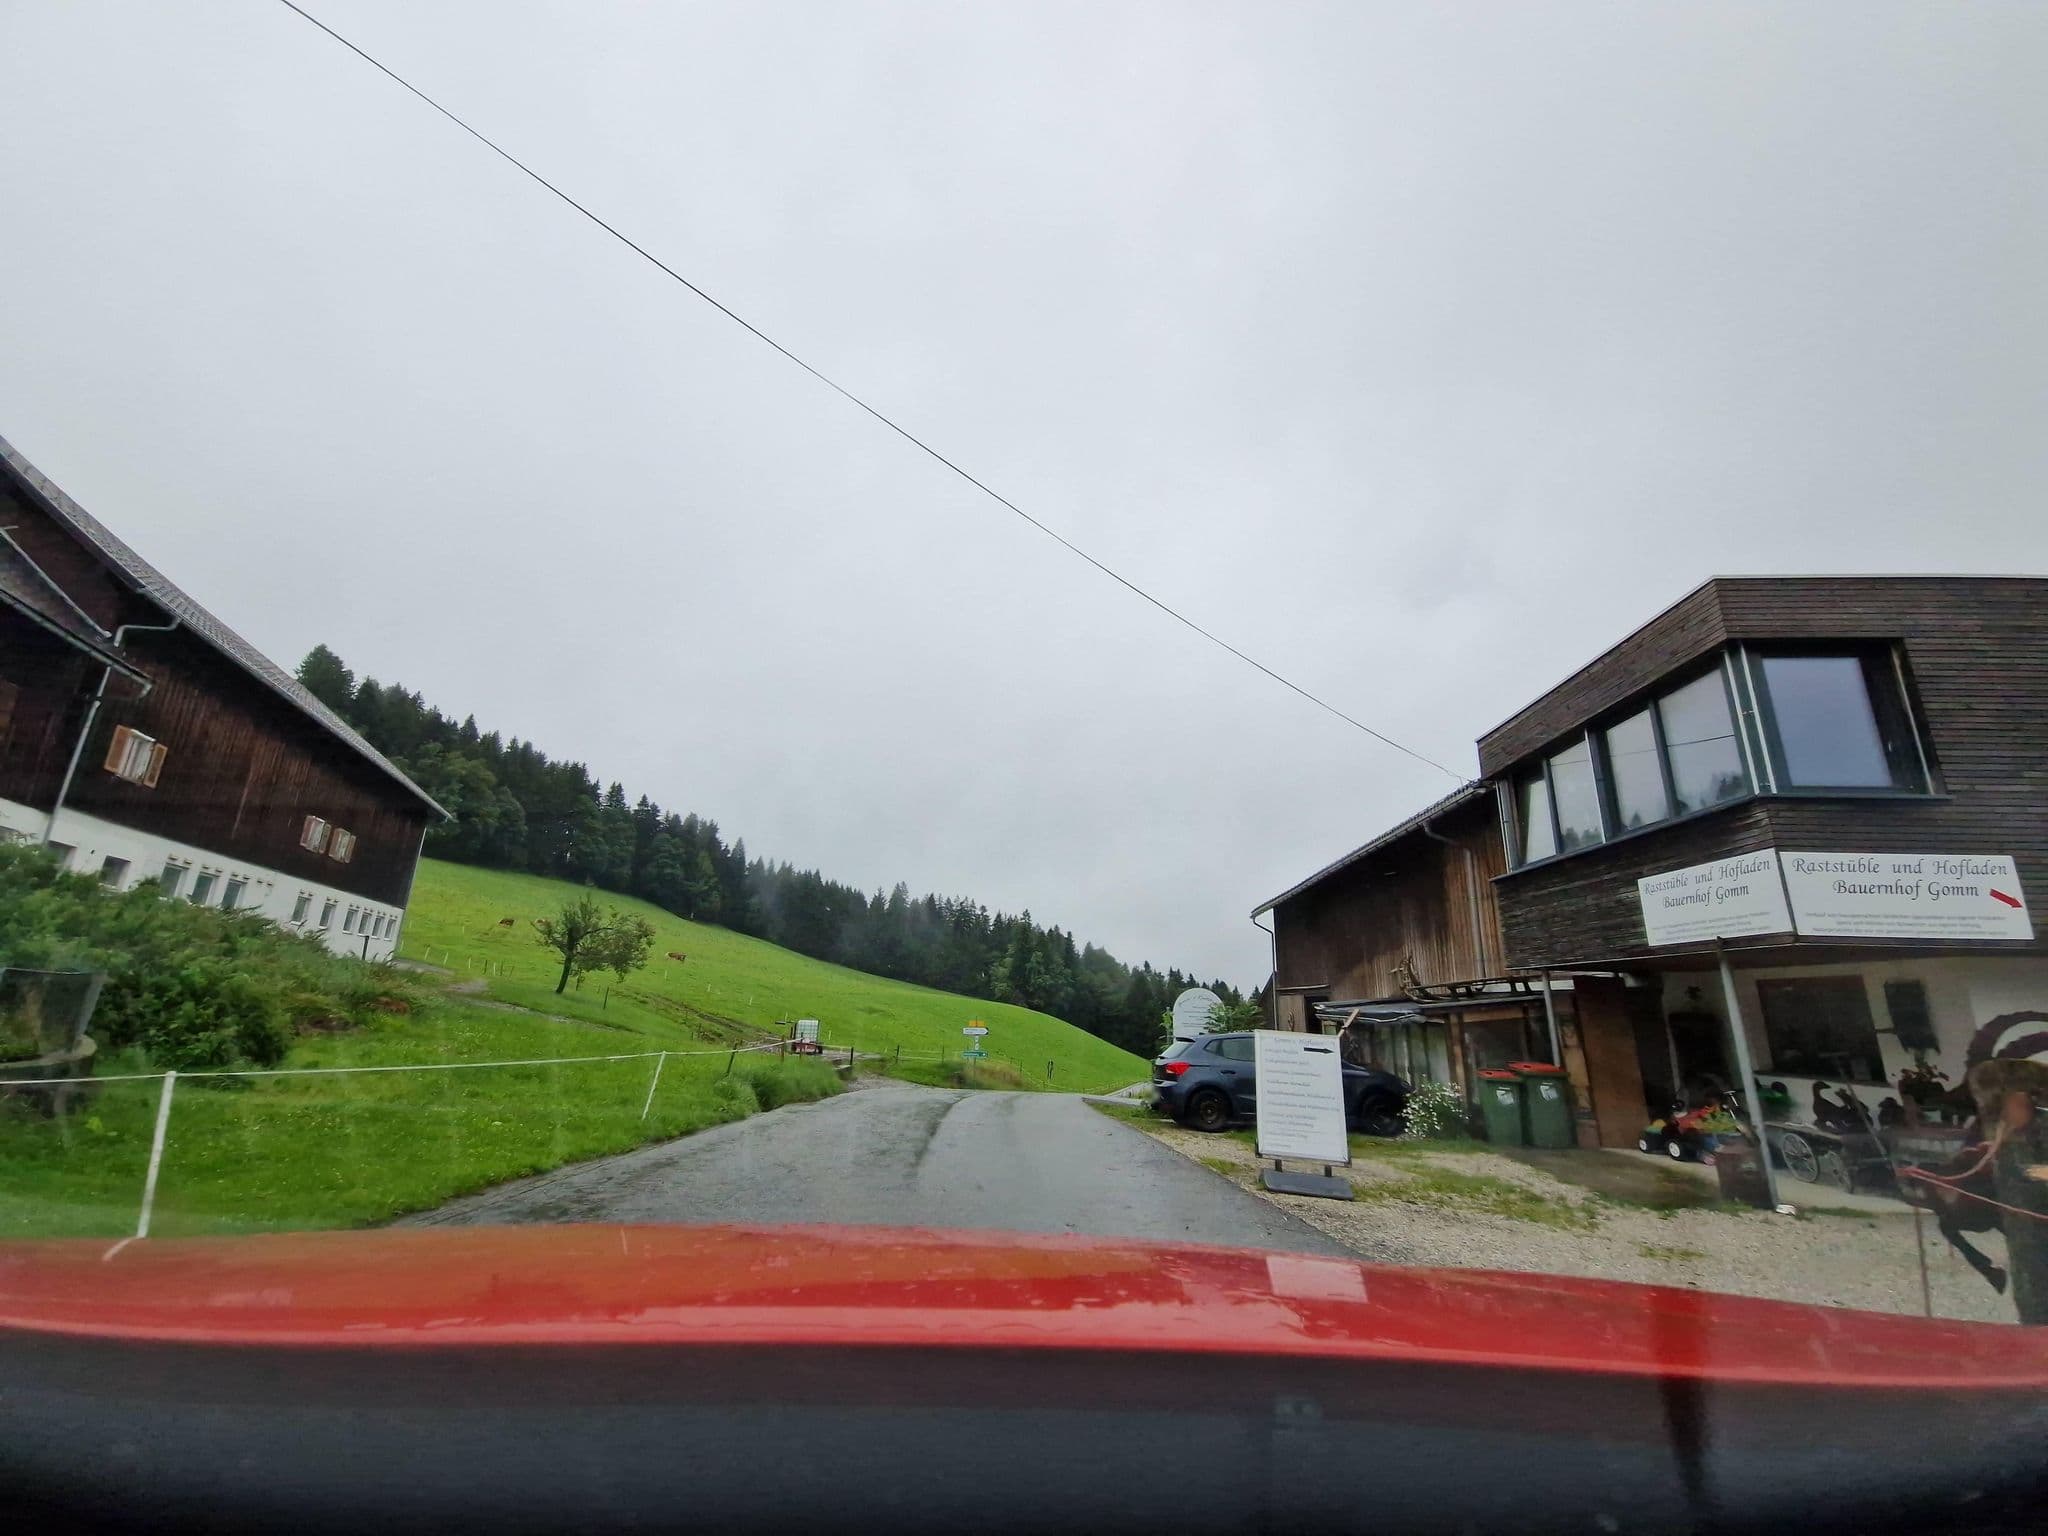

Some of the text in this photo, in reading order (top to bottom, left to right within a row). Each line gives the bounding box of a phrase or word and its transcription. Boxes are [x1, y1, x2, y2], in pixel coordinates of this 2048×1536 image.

[1644, 857, 1770, 895] Raststüble und Hofladen
[1792, 857, 2008, 880] Raststüble und Hofladen
[1664, 885, 1749, 908] Bauernhof Gomm
[1833, 879, 1979, 901] Bauernhof Gomm
